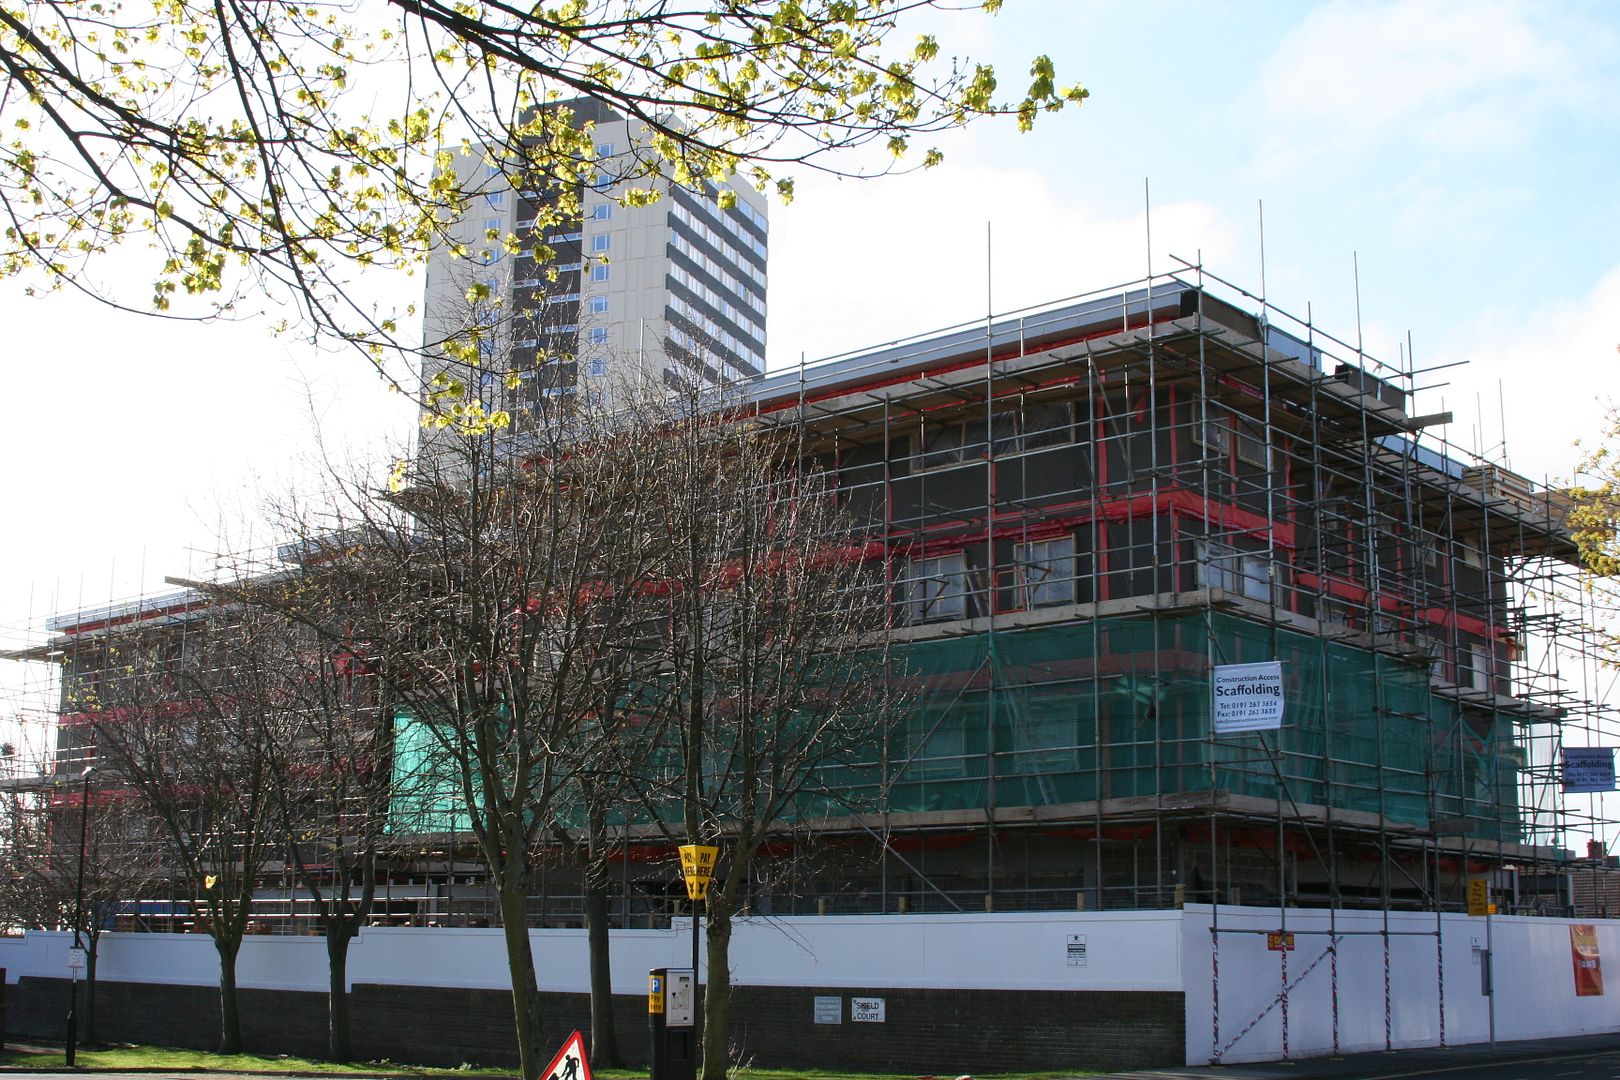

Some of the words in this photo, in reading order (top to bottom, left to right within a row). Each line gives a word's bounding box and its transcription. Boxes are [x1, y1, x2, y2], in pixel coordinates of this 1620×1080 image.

[1216, 675, 1257, 683] Construction
[1216, 683, 1280, 697] Scaffolding
[1565, 760, 1613, 770] Scaffolding
[700, 852, 711, 863] PAY
[697, 866, 711, 877] HERE
[652, 979, 659, 991] P
[856, 1012, 879, 1020] COURT
